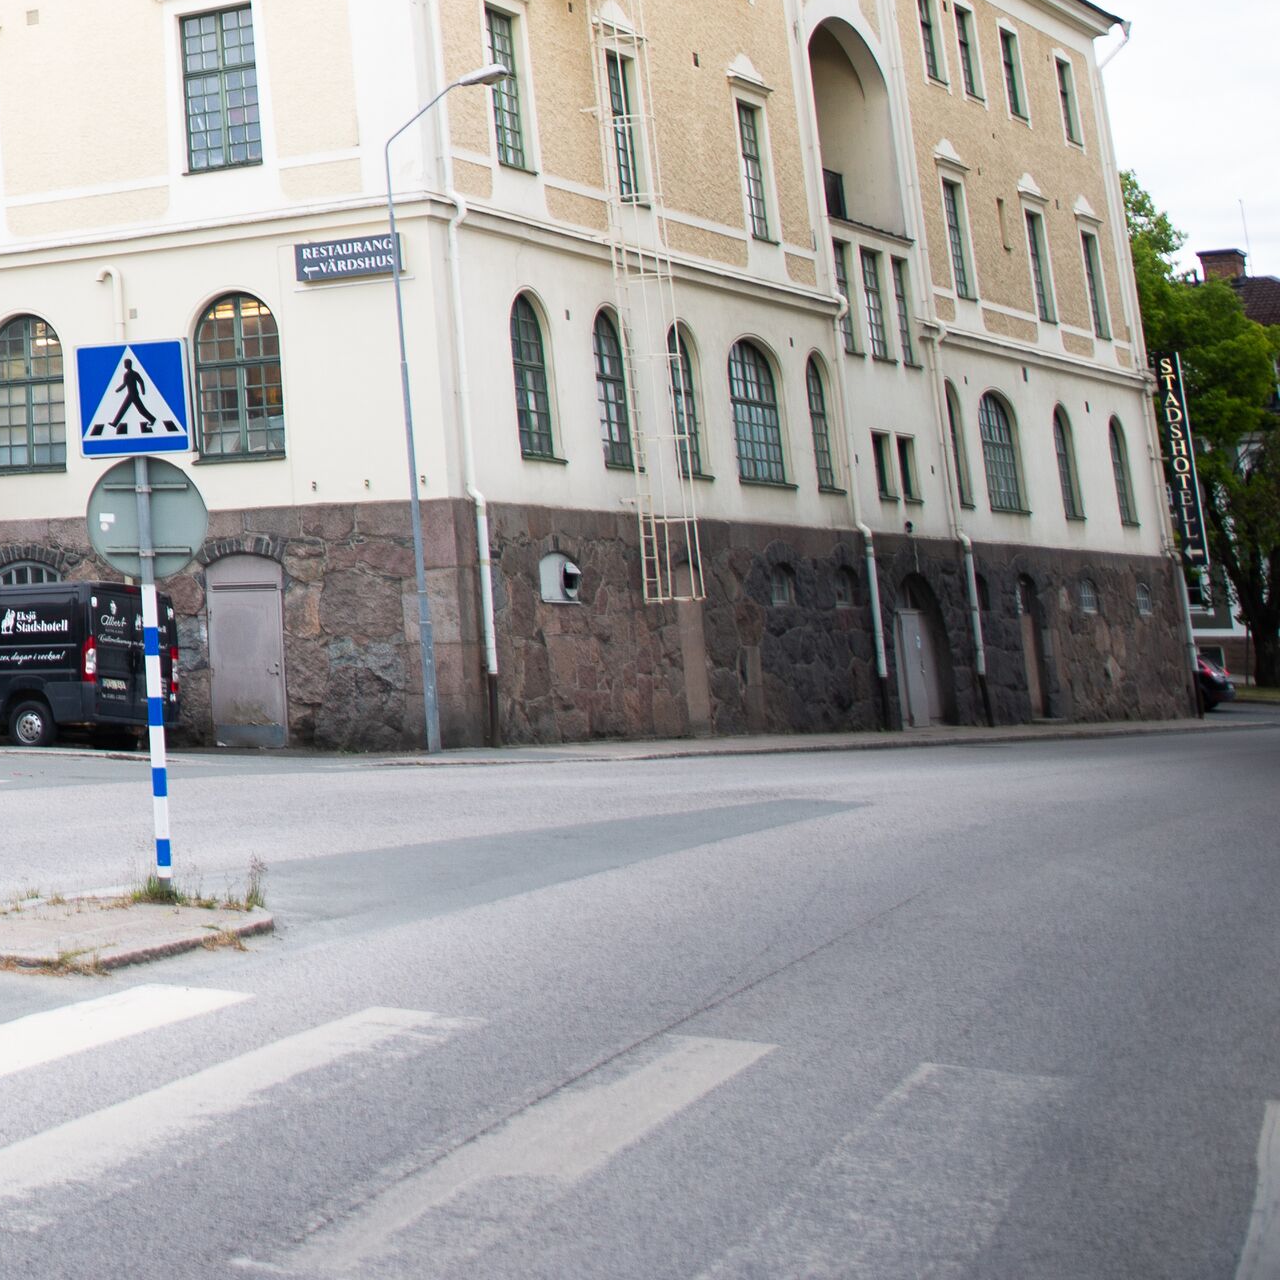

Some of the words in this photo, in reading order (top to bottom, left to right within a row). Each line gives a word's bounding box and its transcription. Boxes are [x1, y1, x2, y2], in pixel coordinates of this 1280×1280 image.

[302, 237, 393, 260] RESTAURANG
[319, 254, 394, 273] VÄRDSHUS
[1159, 357, 1199, 539] STADSHOTELL
[16, 611, 37, 623] Eksjö
[100, 615, 126, 627] Albert
[15, 619, 68, 633] Stadshotell
[11, 652, 32, 665] dagar
[38, 650, 66, 660] veckan!
